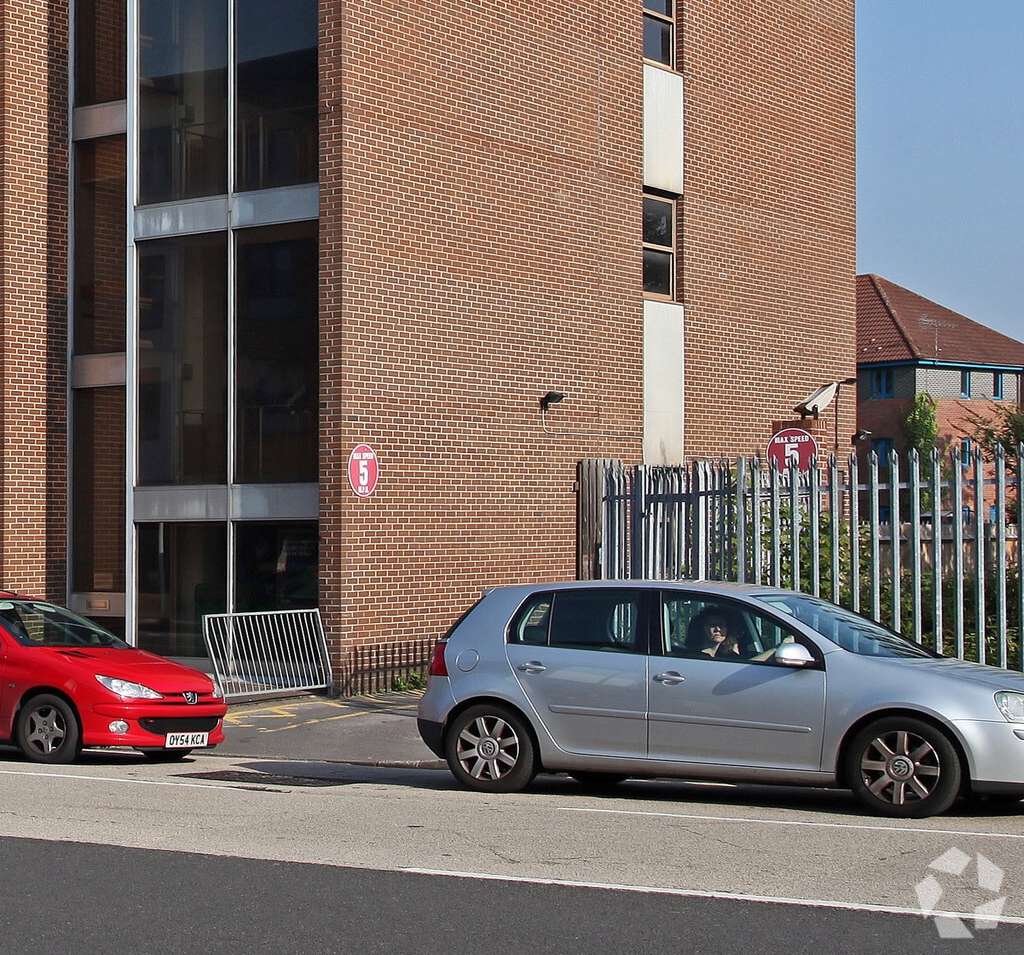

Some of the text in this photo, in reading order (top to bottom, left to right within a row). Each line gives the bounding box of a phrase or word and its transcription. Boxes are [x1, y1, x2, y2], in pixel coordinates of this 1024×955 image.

[790, 435, 810, 443] SPEED
[784, 443, 800, 467] 5
[359, 459, 369, 486] 5
[169, 733, 205, 746] OY54 KCA
